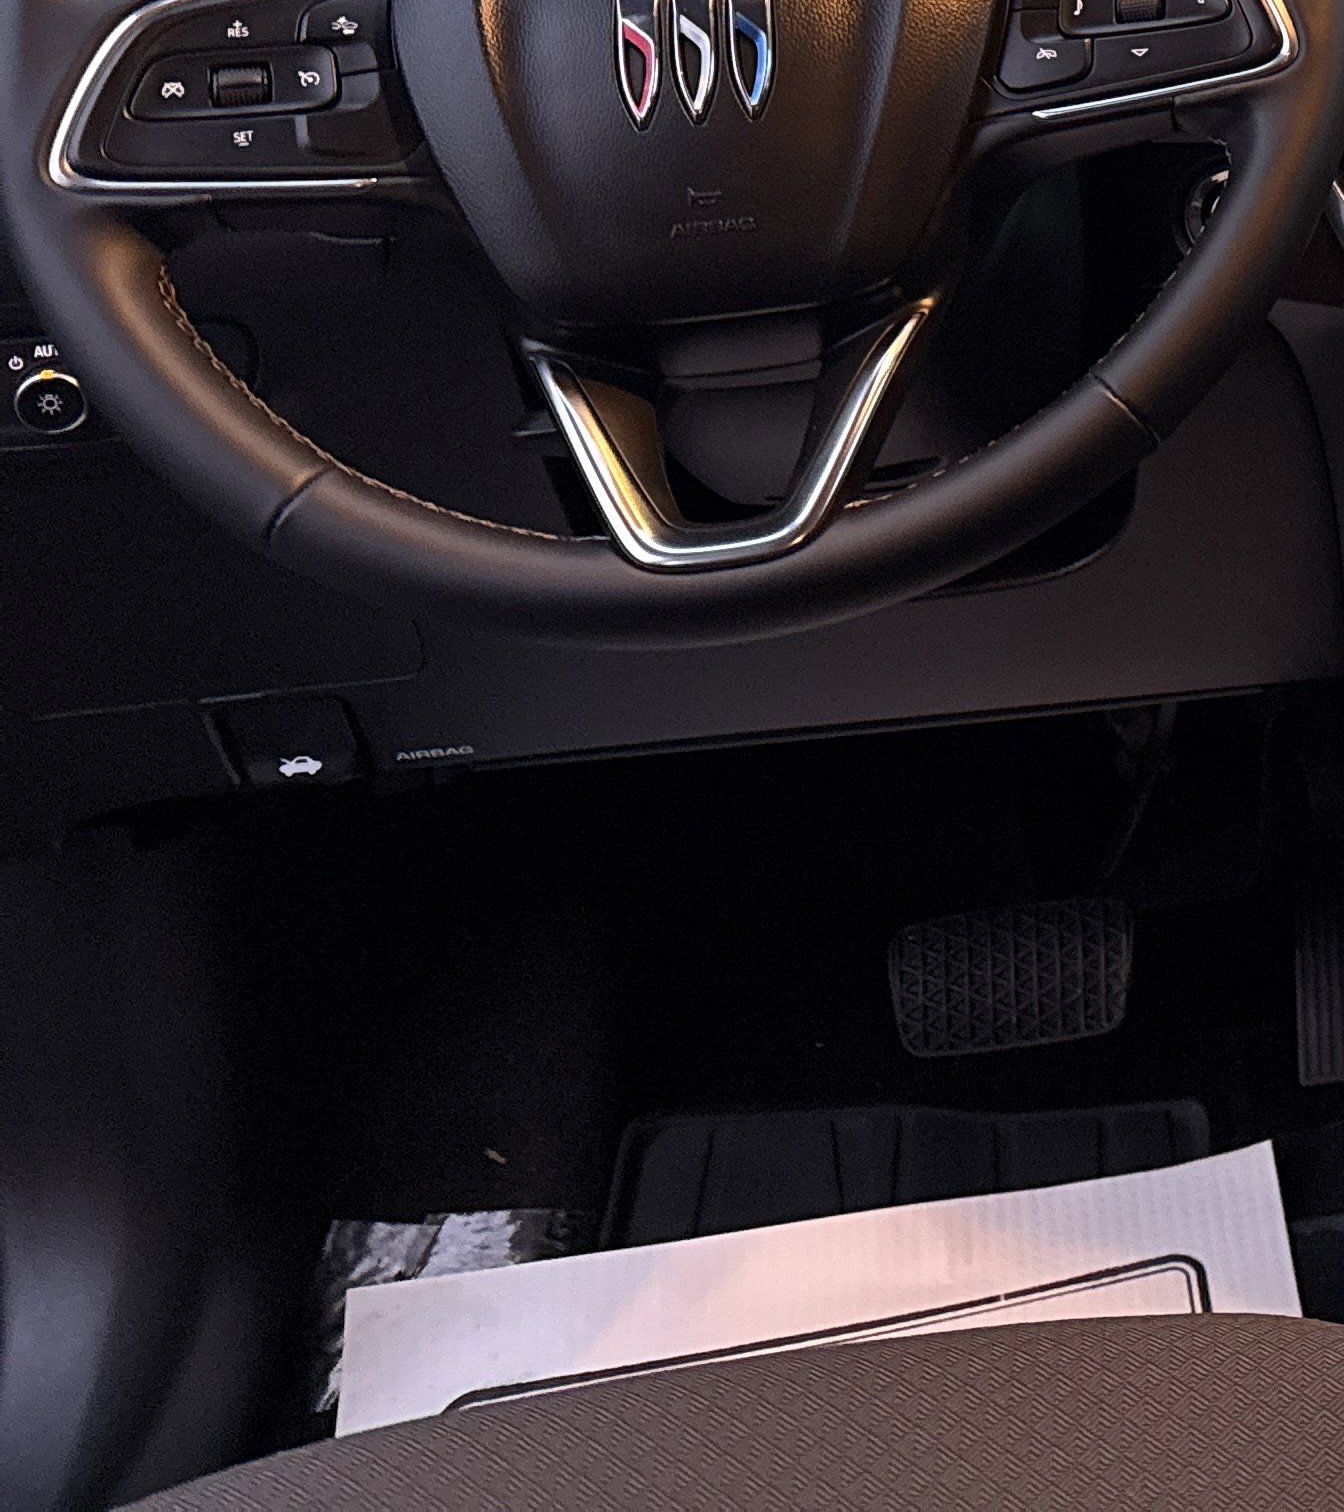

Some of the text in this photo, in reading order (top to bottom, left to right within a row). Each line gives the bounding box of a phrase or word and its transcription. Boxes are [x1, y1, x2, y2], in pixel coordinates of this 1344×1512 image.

[227, 25, 249, 38] RES
[233, 130, 254, 143] SET
[396, 745, 475, 761] AIRBAG
